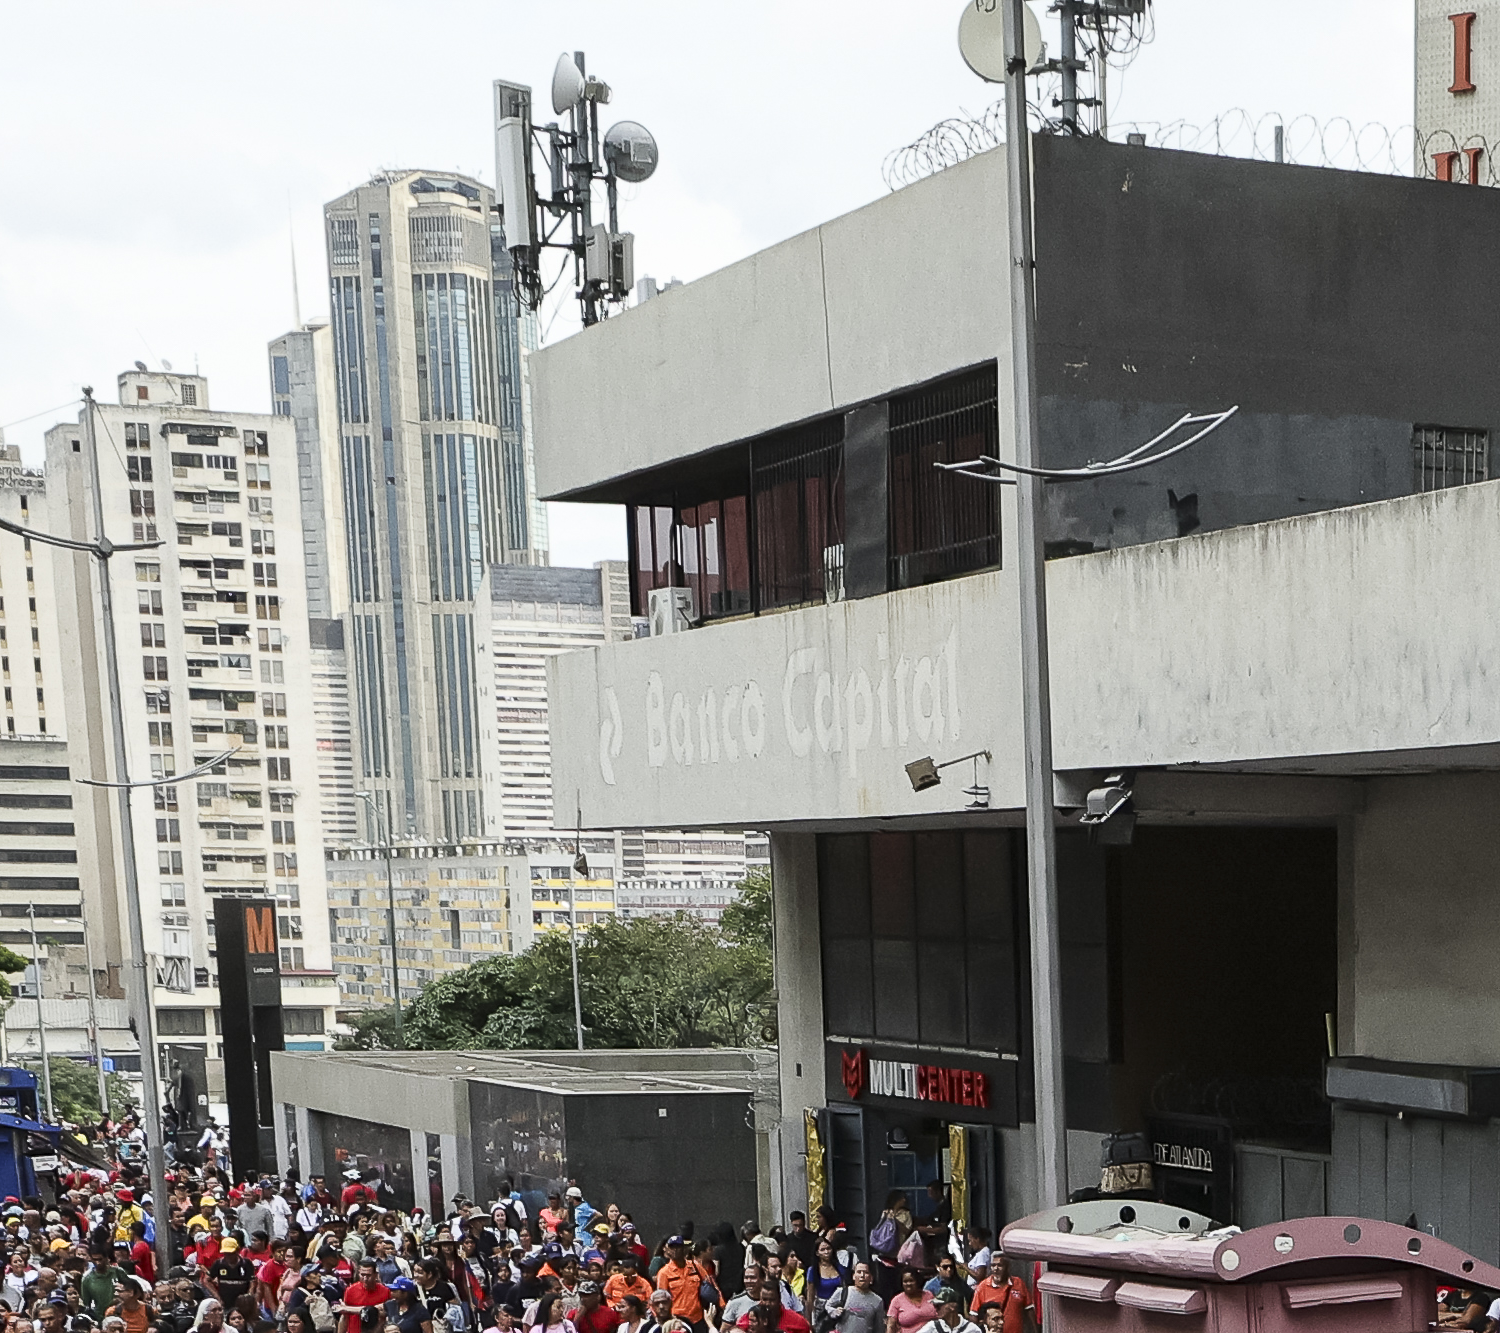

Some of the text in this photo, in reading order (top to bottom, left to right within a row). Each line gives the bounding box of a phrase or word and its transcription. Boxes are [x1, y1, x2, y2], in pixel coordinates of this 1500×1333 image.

[647, 622, 961, 778] Banco Capital
[869, 1059, 987, 1108] MULTICENTER
